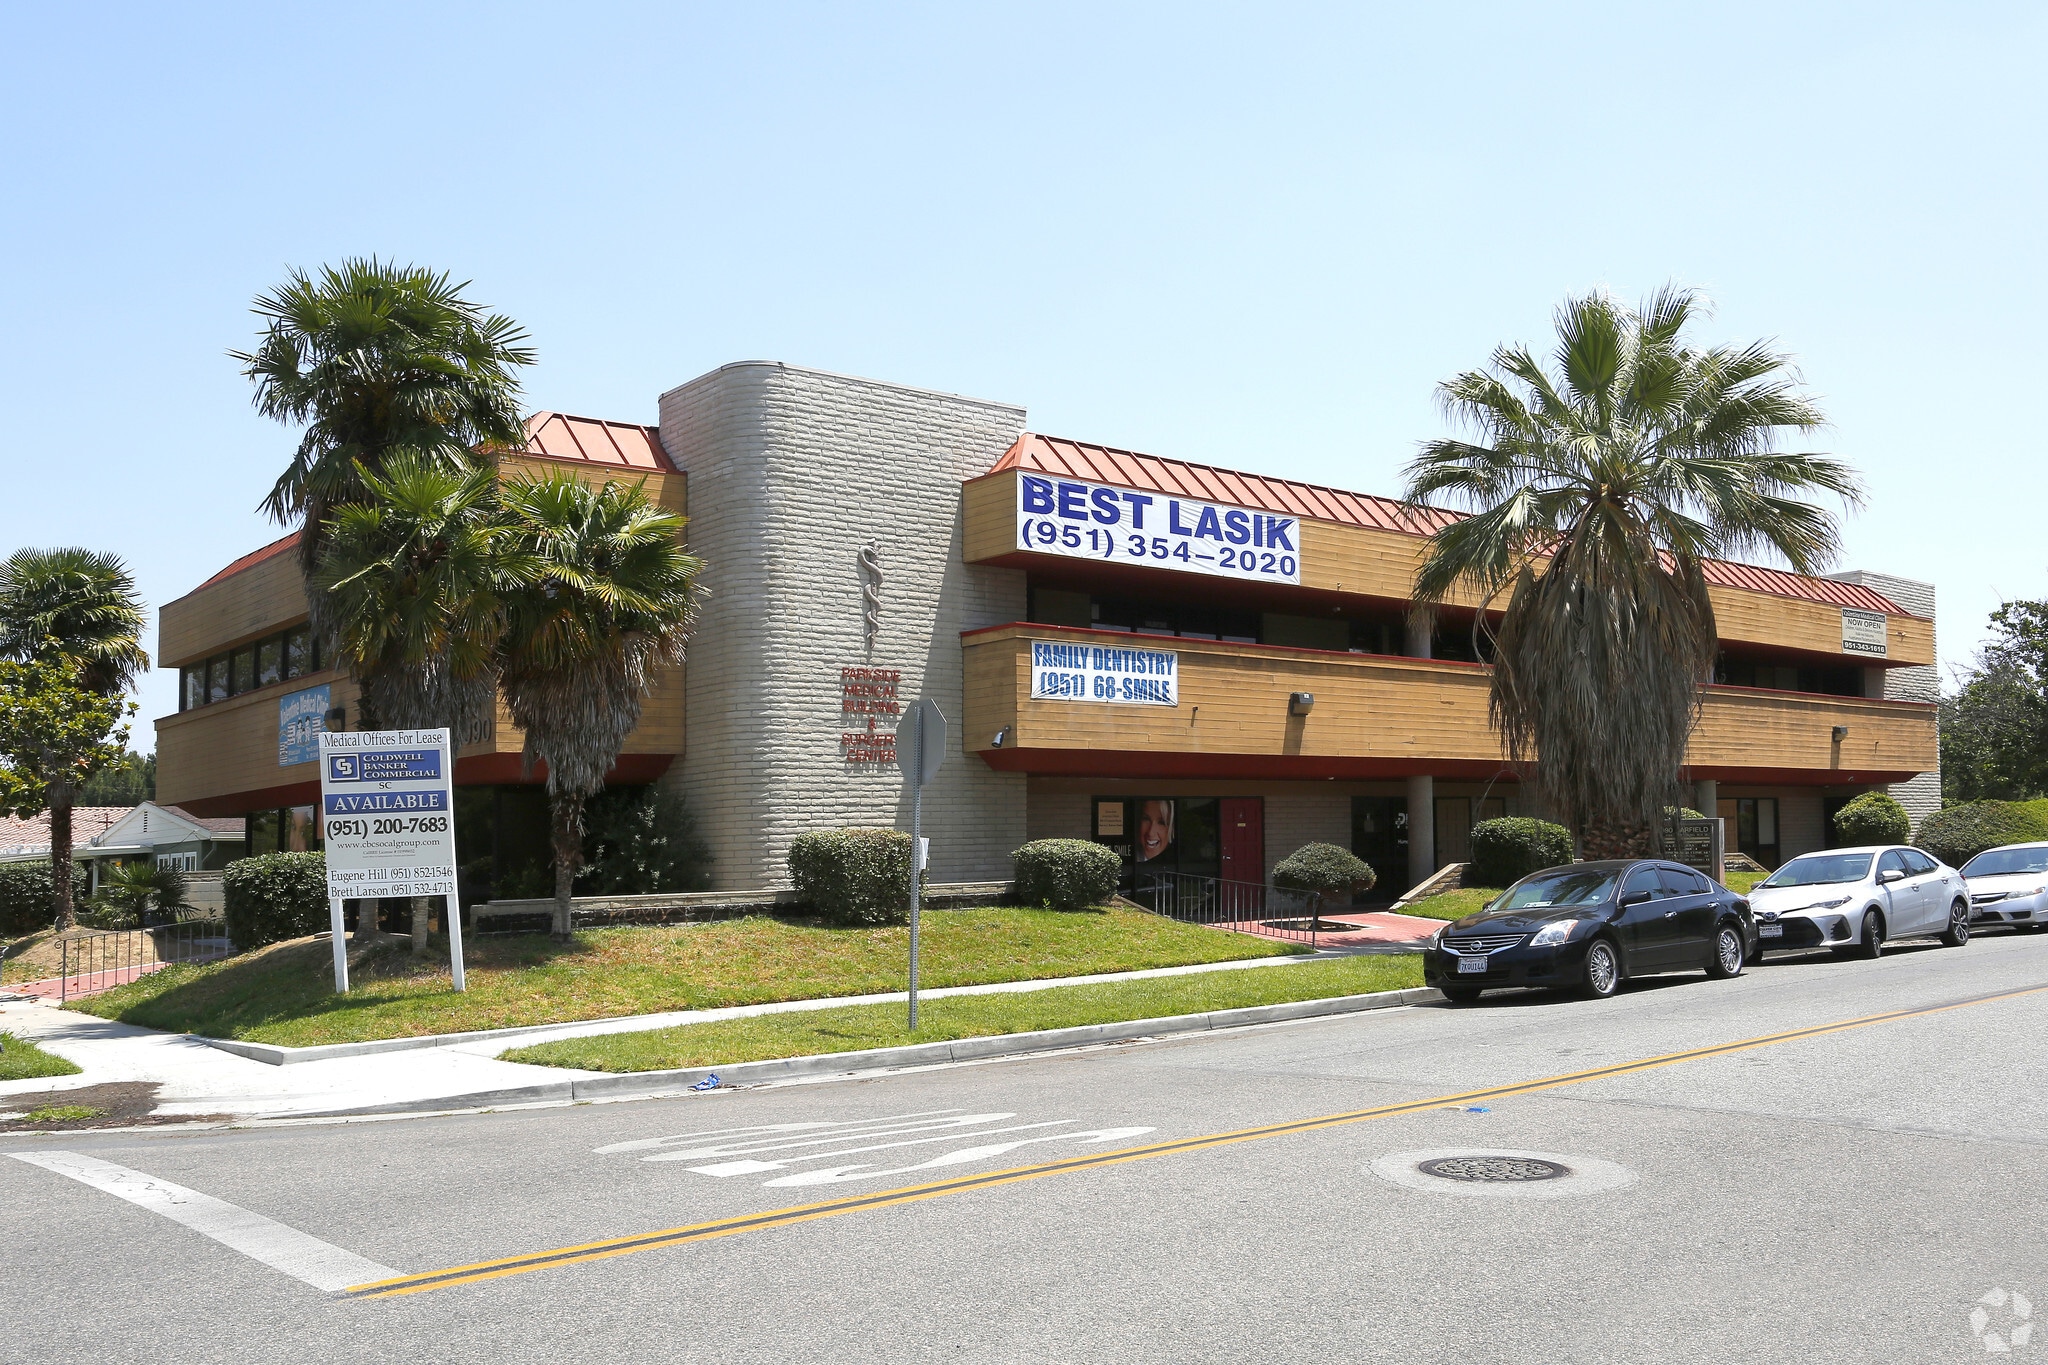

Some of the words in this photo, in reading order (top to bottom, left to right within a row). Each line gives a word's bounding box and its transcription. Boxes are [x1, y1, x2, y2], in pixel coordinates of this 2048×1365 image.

[1022, 476, 1152, 529] BEST
[1169, 500, 1295, 551] LASIK
[1022, 519, 1114, 557] (951)
[1847, 618, 1862, 626] NOW
[1864, 621, 1880, 629] OPEN
[1861, 612, 1874, 620] Medical
[1875, 614, 1885, 622] Clinic
[1034, 643, 1088, 670] FAMILY
[1093, 647, 1174, 675] DENTISTRY
[841, 667, 901, 682] PARKSIDE
[844, 684, 898, 698] MEDICAL
[1040, 671, 1085, 697] (951)
[1094, 675, 1170, 700] 68-SMILE
[300, 694, 317, 713] Medical
[843, 700, 900, 713] BUILDING
[868, 717, 876, 730] &
[324, 733, 360, 747] Medical
[363, 731, 396, 746] Offices
[399, 732, 413, 744] For
[417, 730, 442, 744] Lease
[841, 733, 897, 746] SURGER
[363, 753, 424, 762] COLDWELL
[847, 749, 896, 762] CENTER
[364, 762, 408, 770] BANKER
[364, 770, 438, 779] COMMERCIAL
[334, 794, 439, 811] AVAILABLE
[327, 820, 368, 840] (951)
[373, 817, 448, 835] 200-7683
[337, 839, 440, 849] www.cbcsocalgroup.com
[331, 870, 365, 883] Eugene
[368, 869, 387, 880] Hill
[391, 868, 412, 880] (951)
[414, 866, 453, 878] 852-1546
[331, 886, 353, 898] Brett
[357, 885, 388, 897] Larson
[391, 884, 412, 895] (951)
[414, 882, 454, 894] 532-4713
